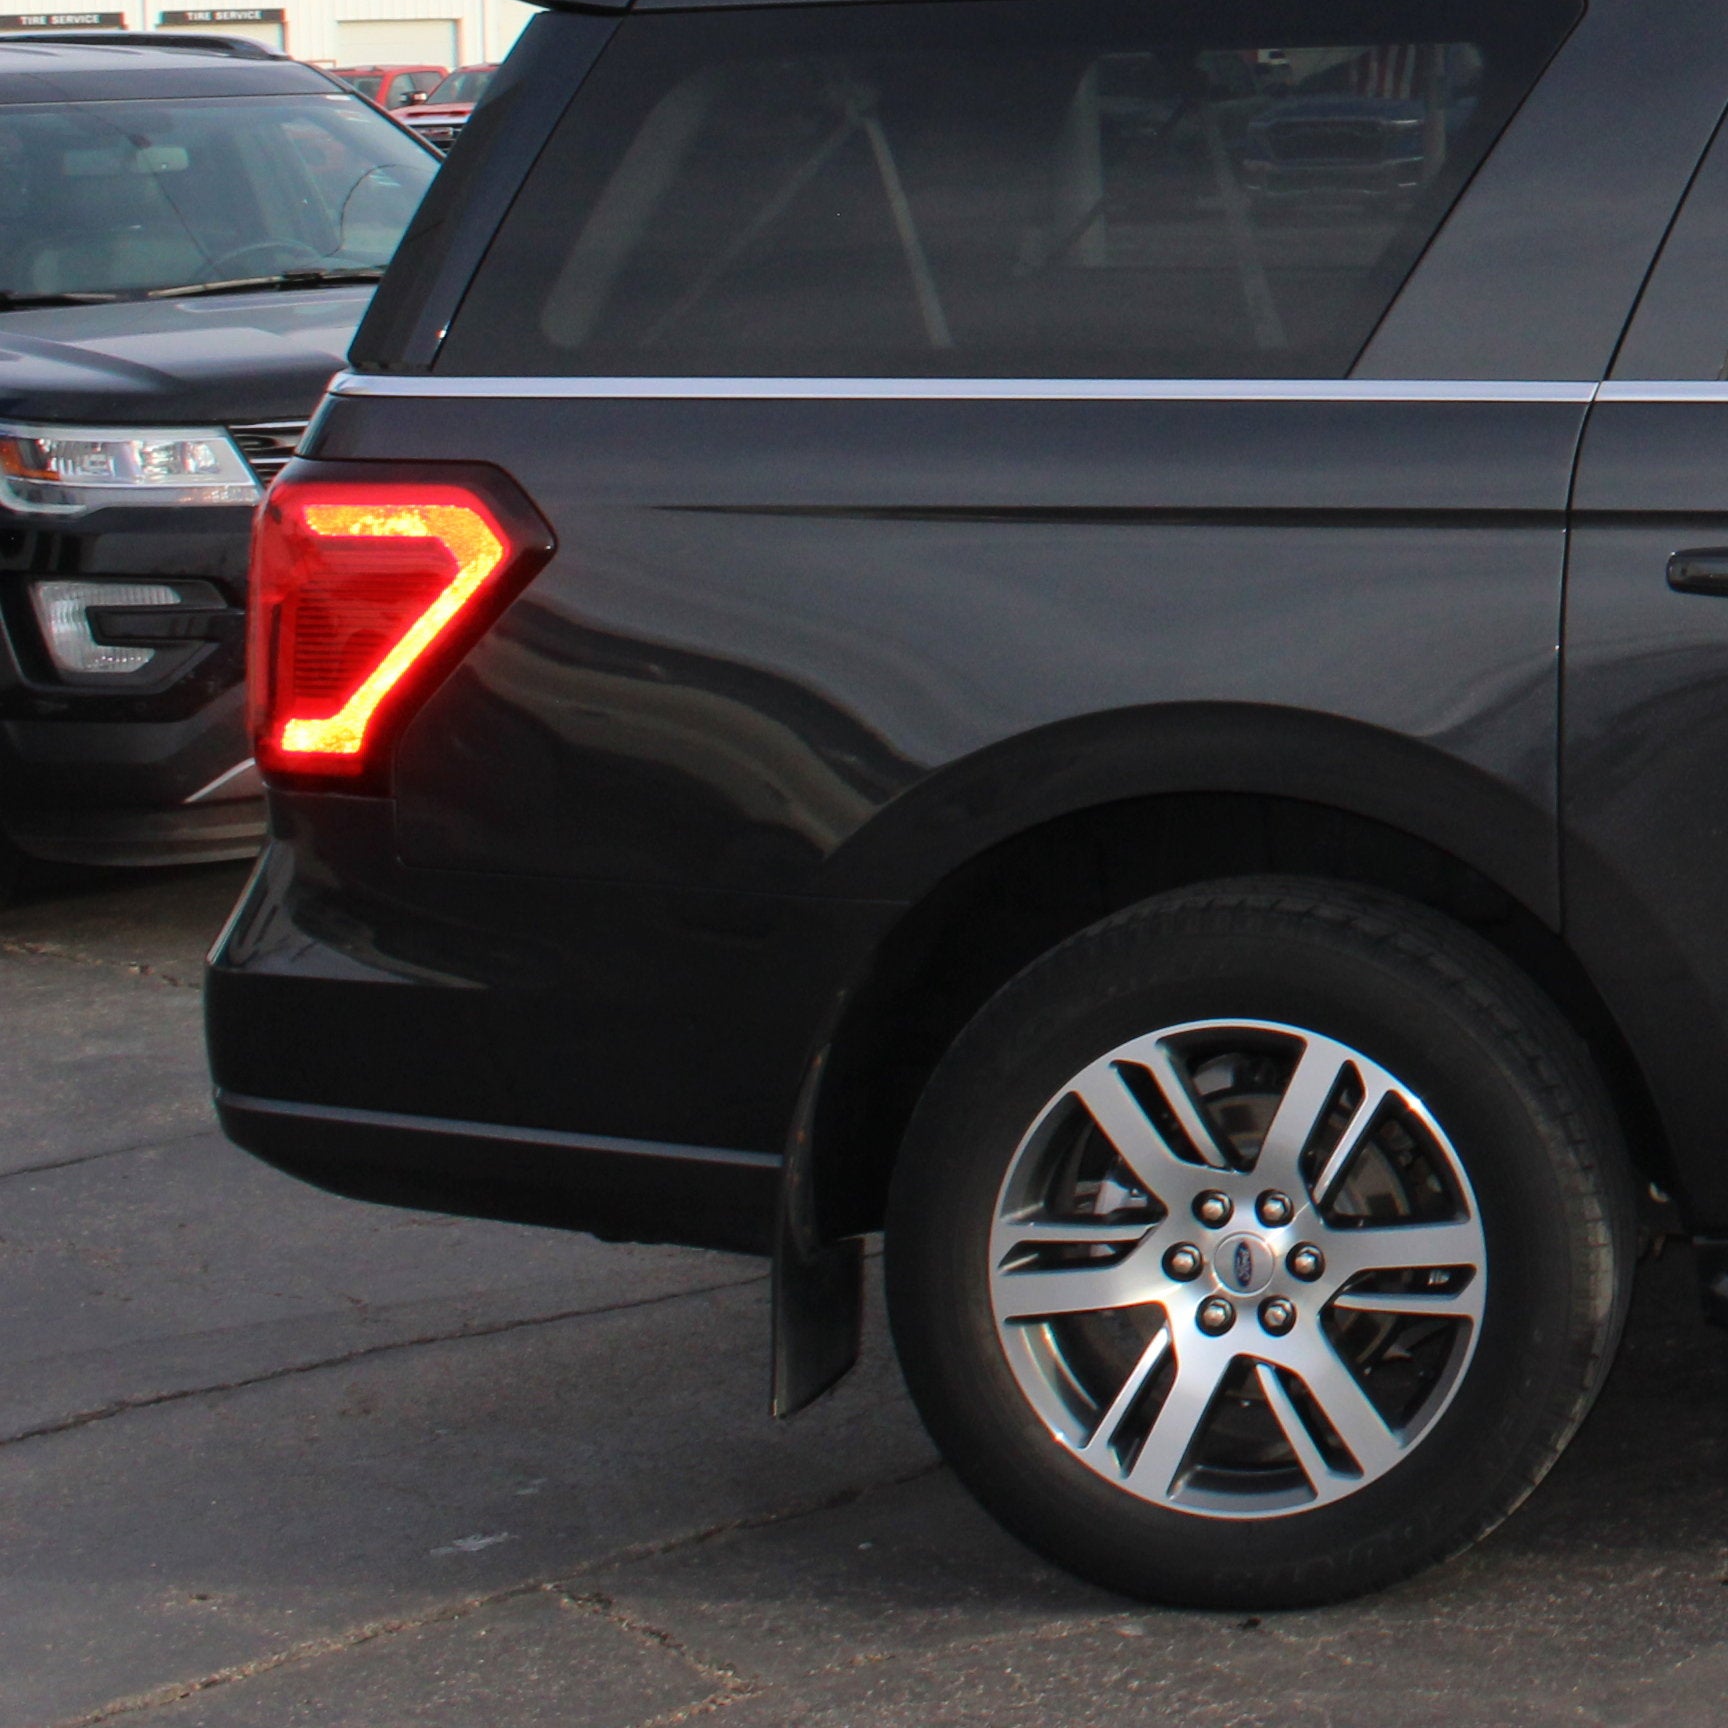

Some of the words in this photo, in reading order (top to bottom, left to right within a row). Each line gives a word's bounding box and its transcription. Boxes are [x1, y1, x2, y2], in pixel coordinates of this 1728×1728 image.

[19, 16, 47, 25] TIRE
[50, 14, 100, 24] SERVICE
[185, 12, 212, 21] TIRE
[214, 10, 262, 20] SERVICE
